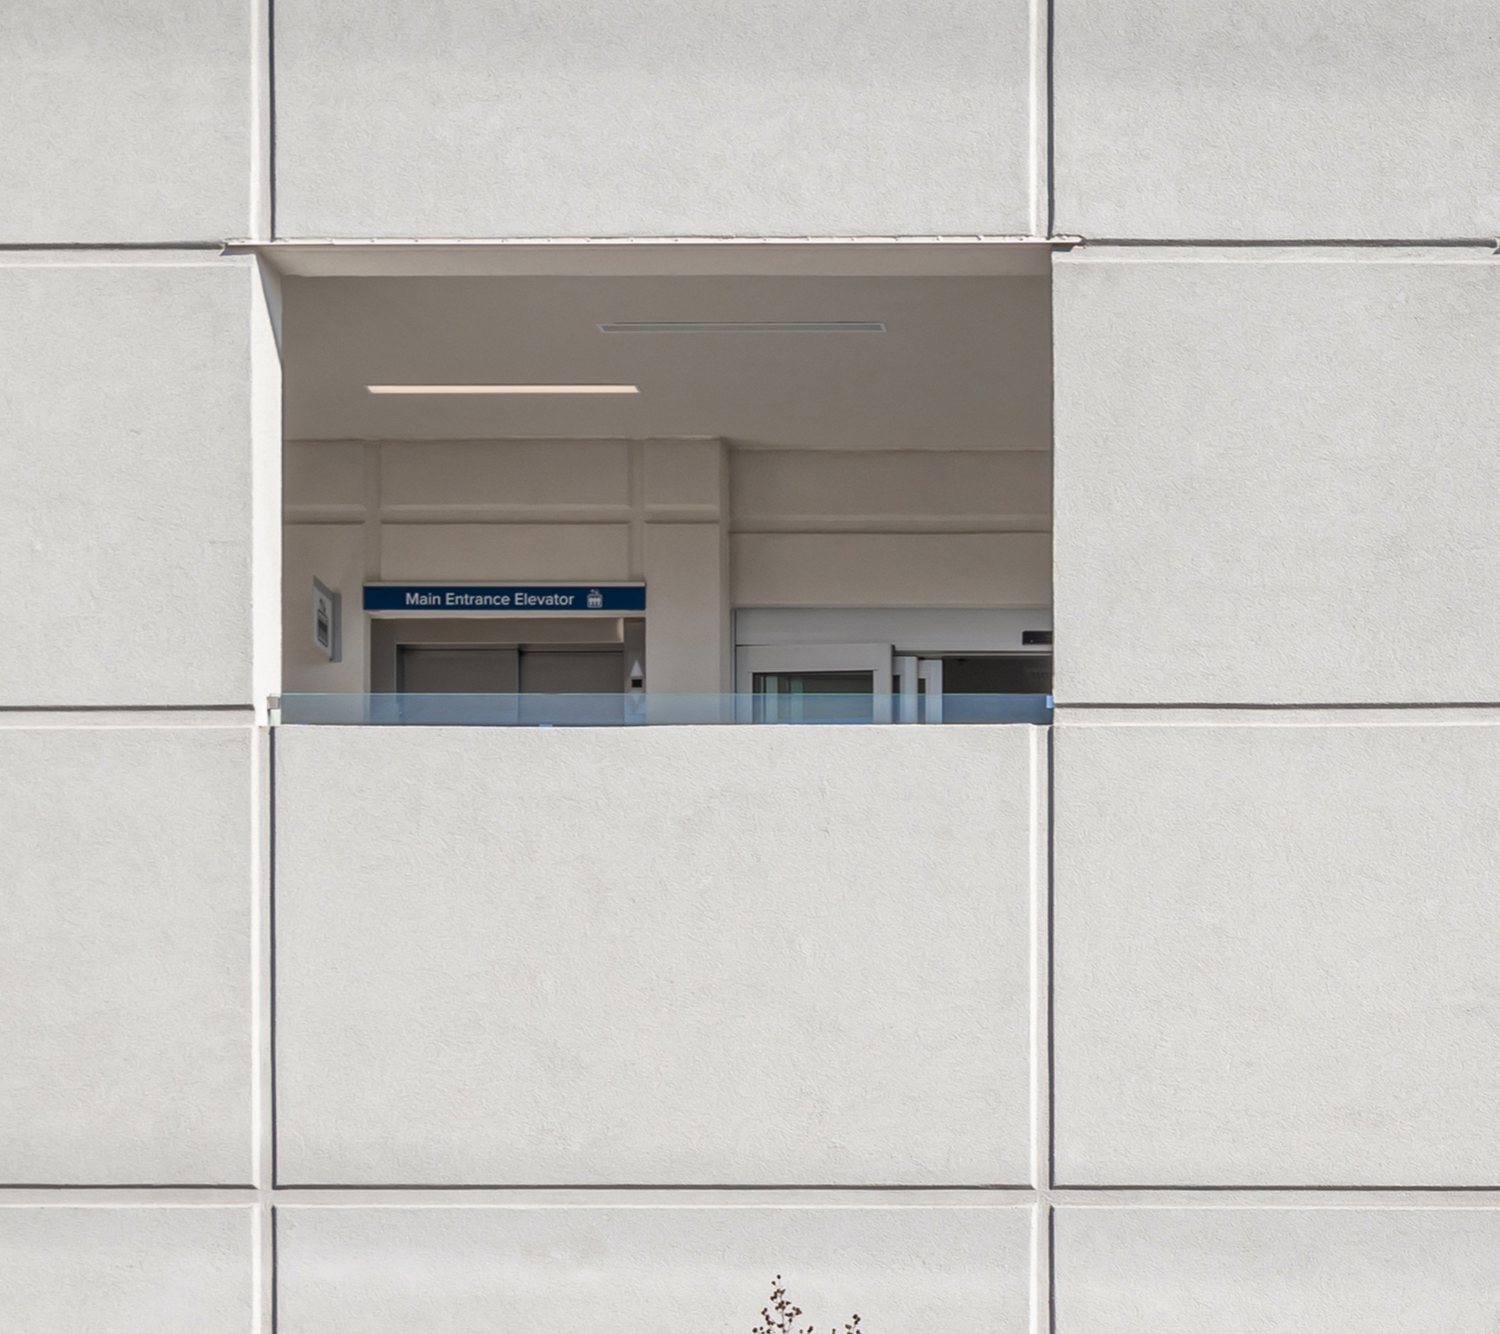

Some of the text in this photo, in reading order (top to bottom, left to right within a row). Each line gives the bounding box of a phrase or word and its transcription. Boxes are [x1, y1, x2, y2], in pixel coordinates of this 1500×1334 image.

[405, 592, 575, 606] Main Entrance Elevator
